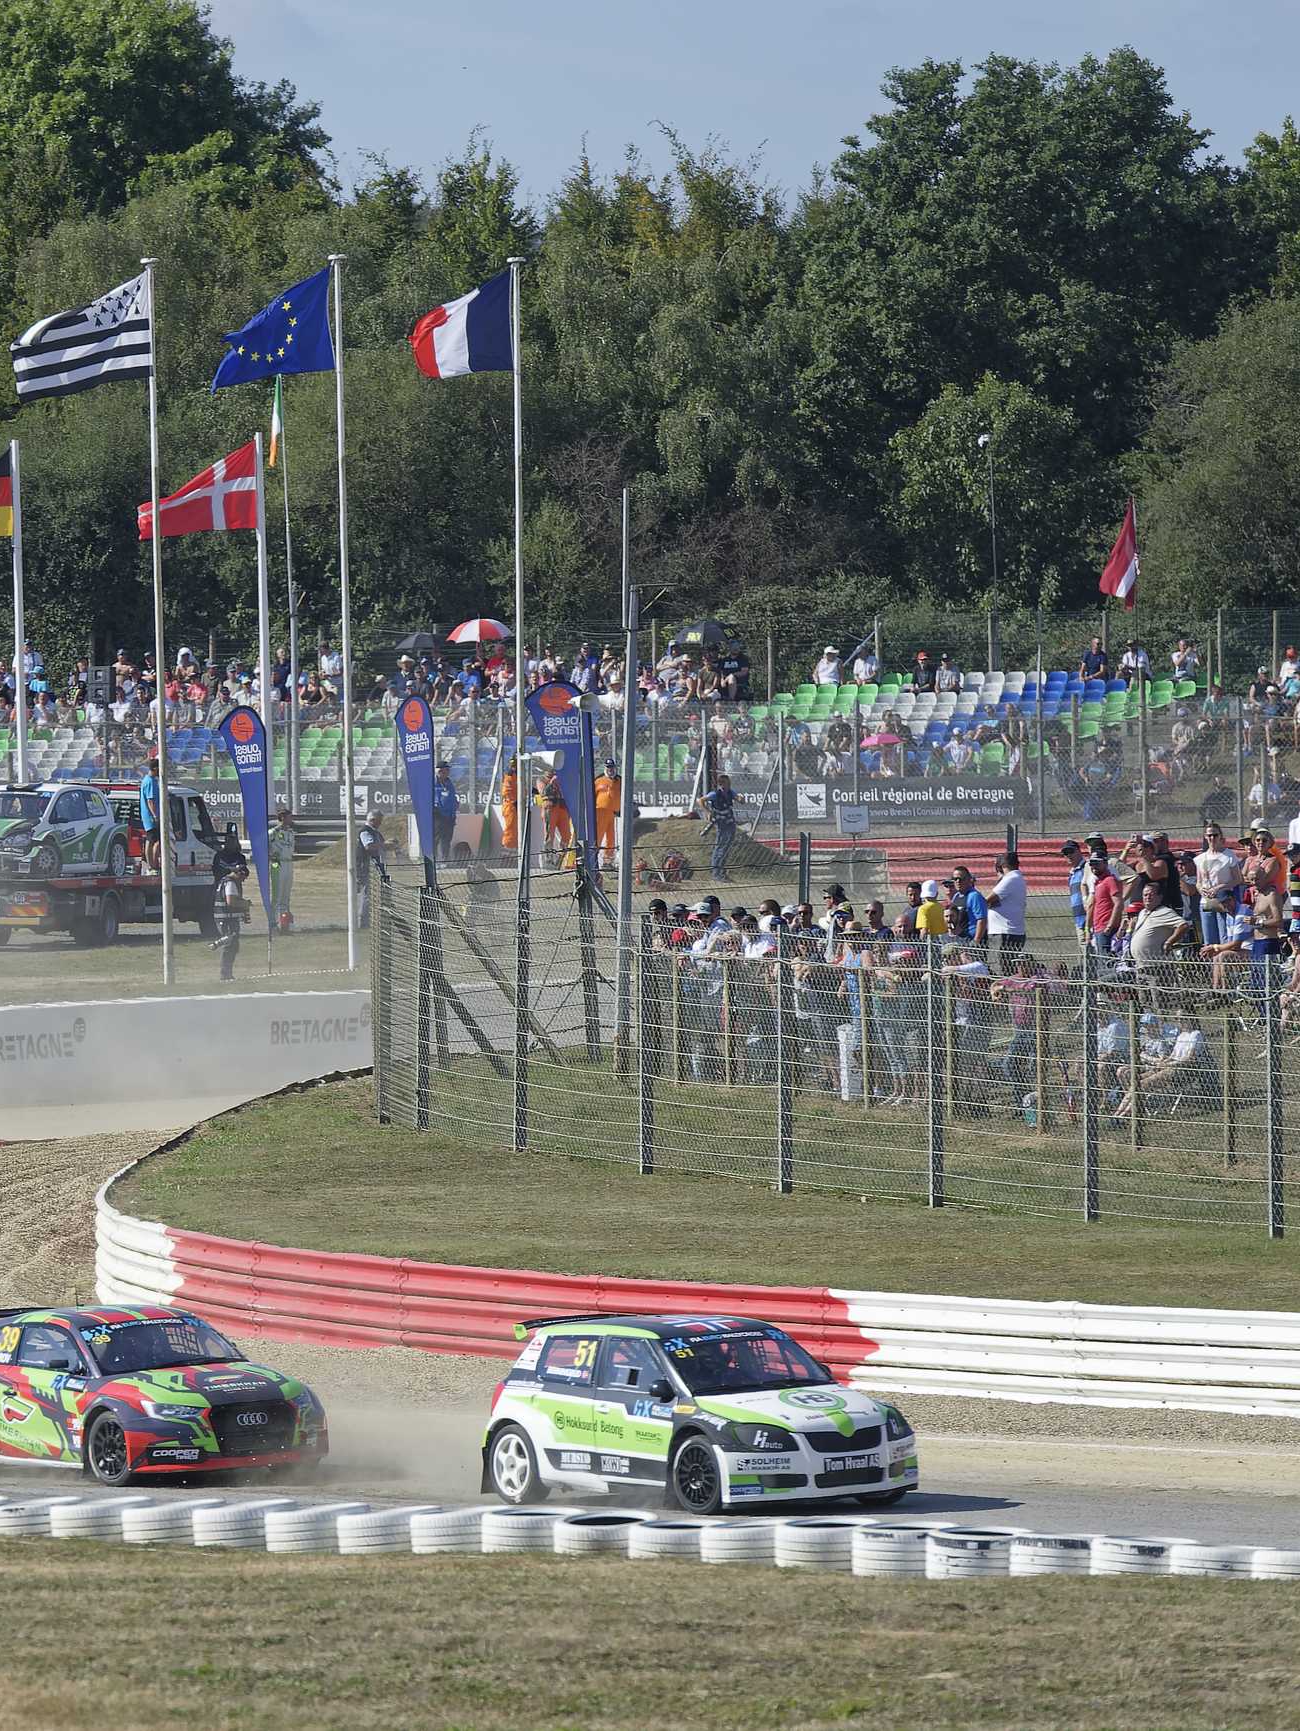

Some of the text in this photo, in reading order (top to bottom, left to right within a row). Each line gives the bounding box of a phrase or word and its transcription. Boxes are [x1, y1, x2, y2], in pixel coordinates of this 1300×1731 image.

[882, 787, 933, 805] régional
[937, 787, 953, 801] de
[956, 786, 1015, 803] Bretagne
[270, 1018, 359, 1045] BRETAGNE
[91, 1334, 111, 1345] 39
[573, 1340, 598, 1367] 51
[674, 1348, 694, 1358] 51
[152, 1449, 200, 1458] COOPER
[751, 1458, 791, 1466] SOLHEIM
[825, 1454, 880, 1471] Tom Hvaal AS
